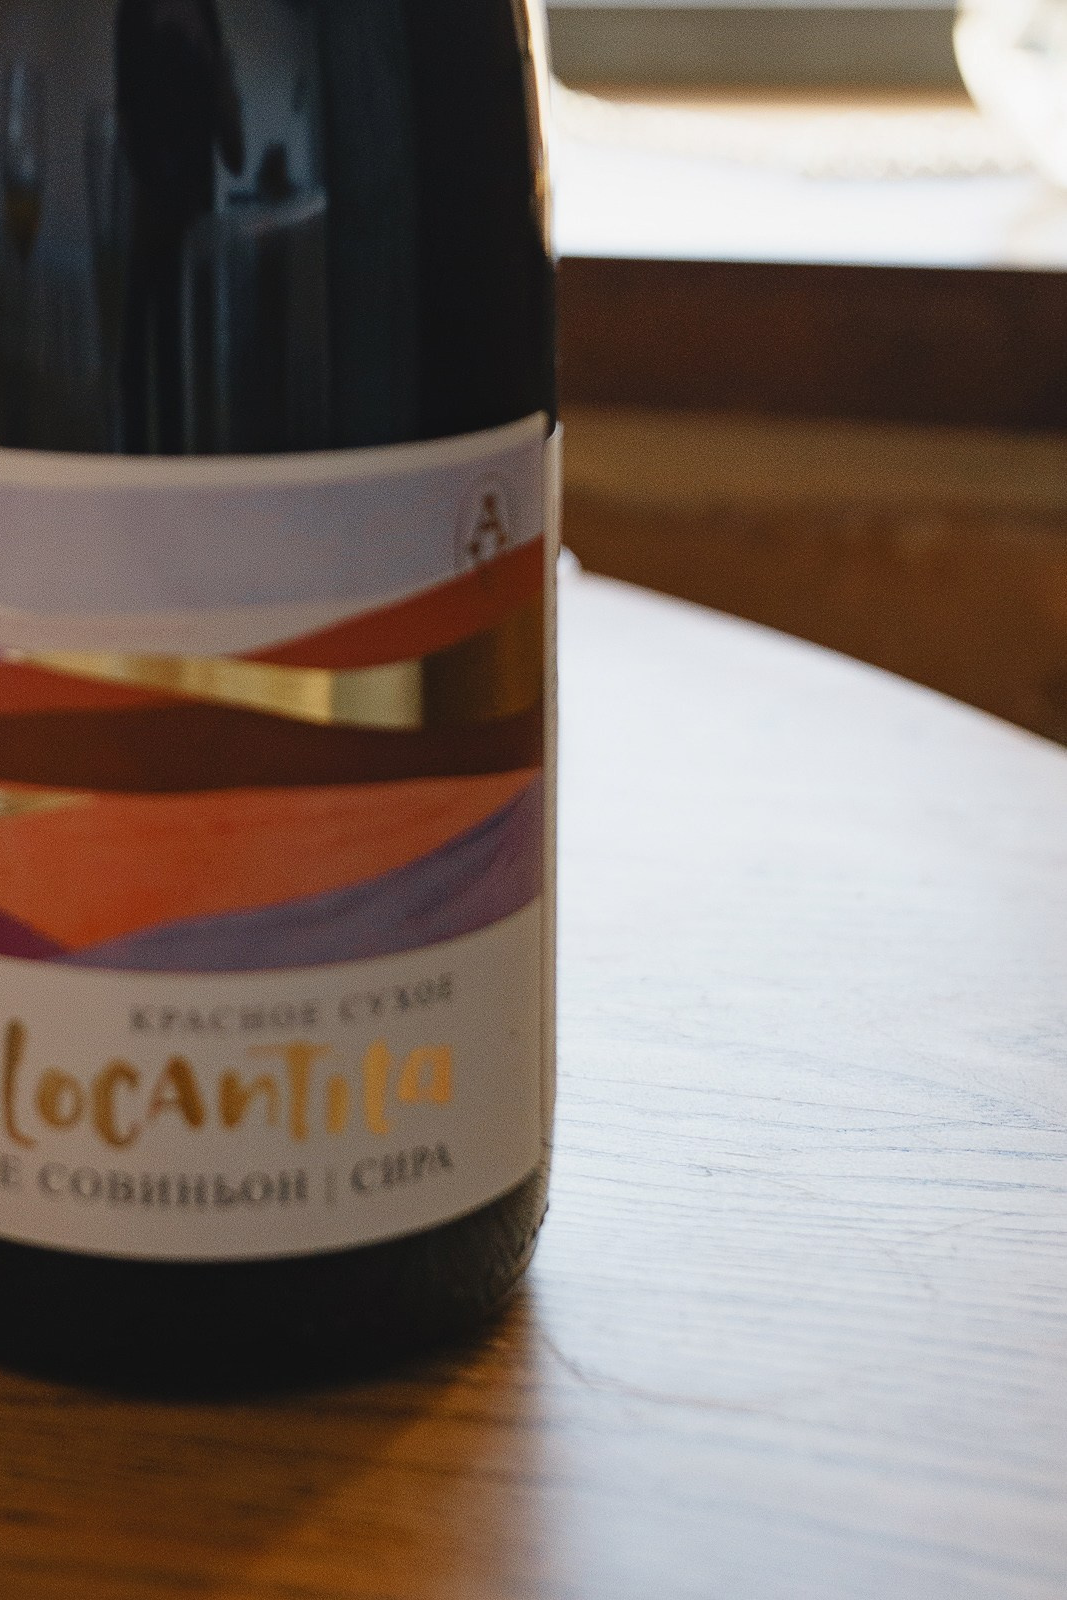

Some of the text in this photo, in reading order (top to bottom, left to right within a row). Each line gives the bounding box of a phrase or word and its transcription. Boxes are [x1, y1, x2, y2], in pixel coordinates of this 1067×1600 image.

[128, 973, 454, 1034] КРАСНОЕ СУХОЕ
[36, 1162, 309, 1209] СОВИНЬОН
[349, 1142, 455, 1197] СИРА
